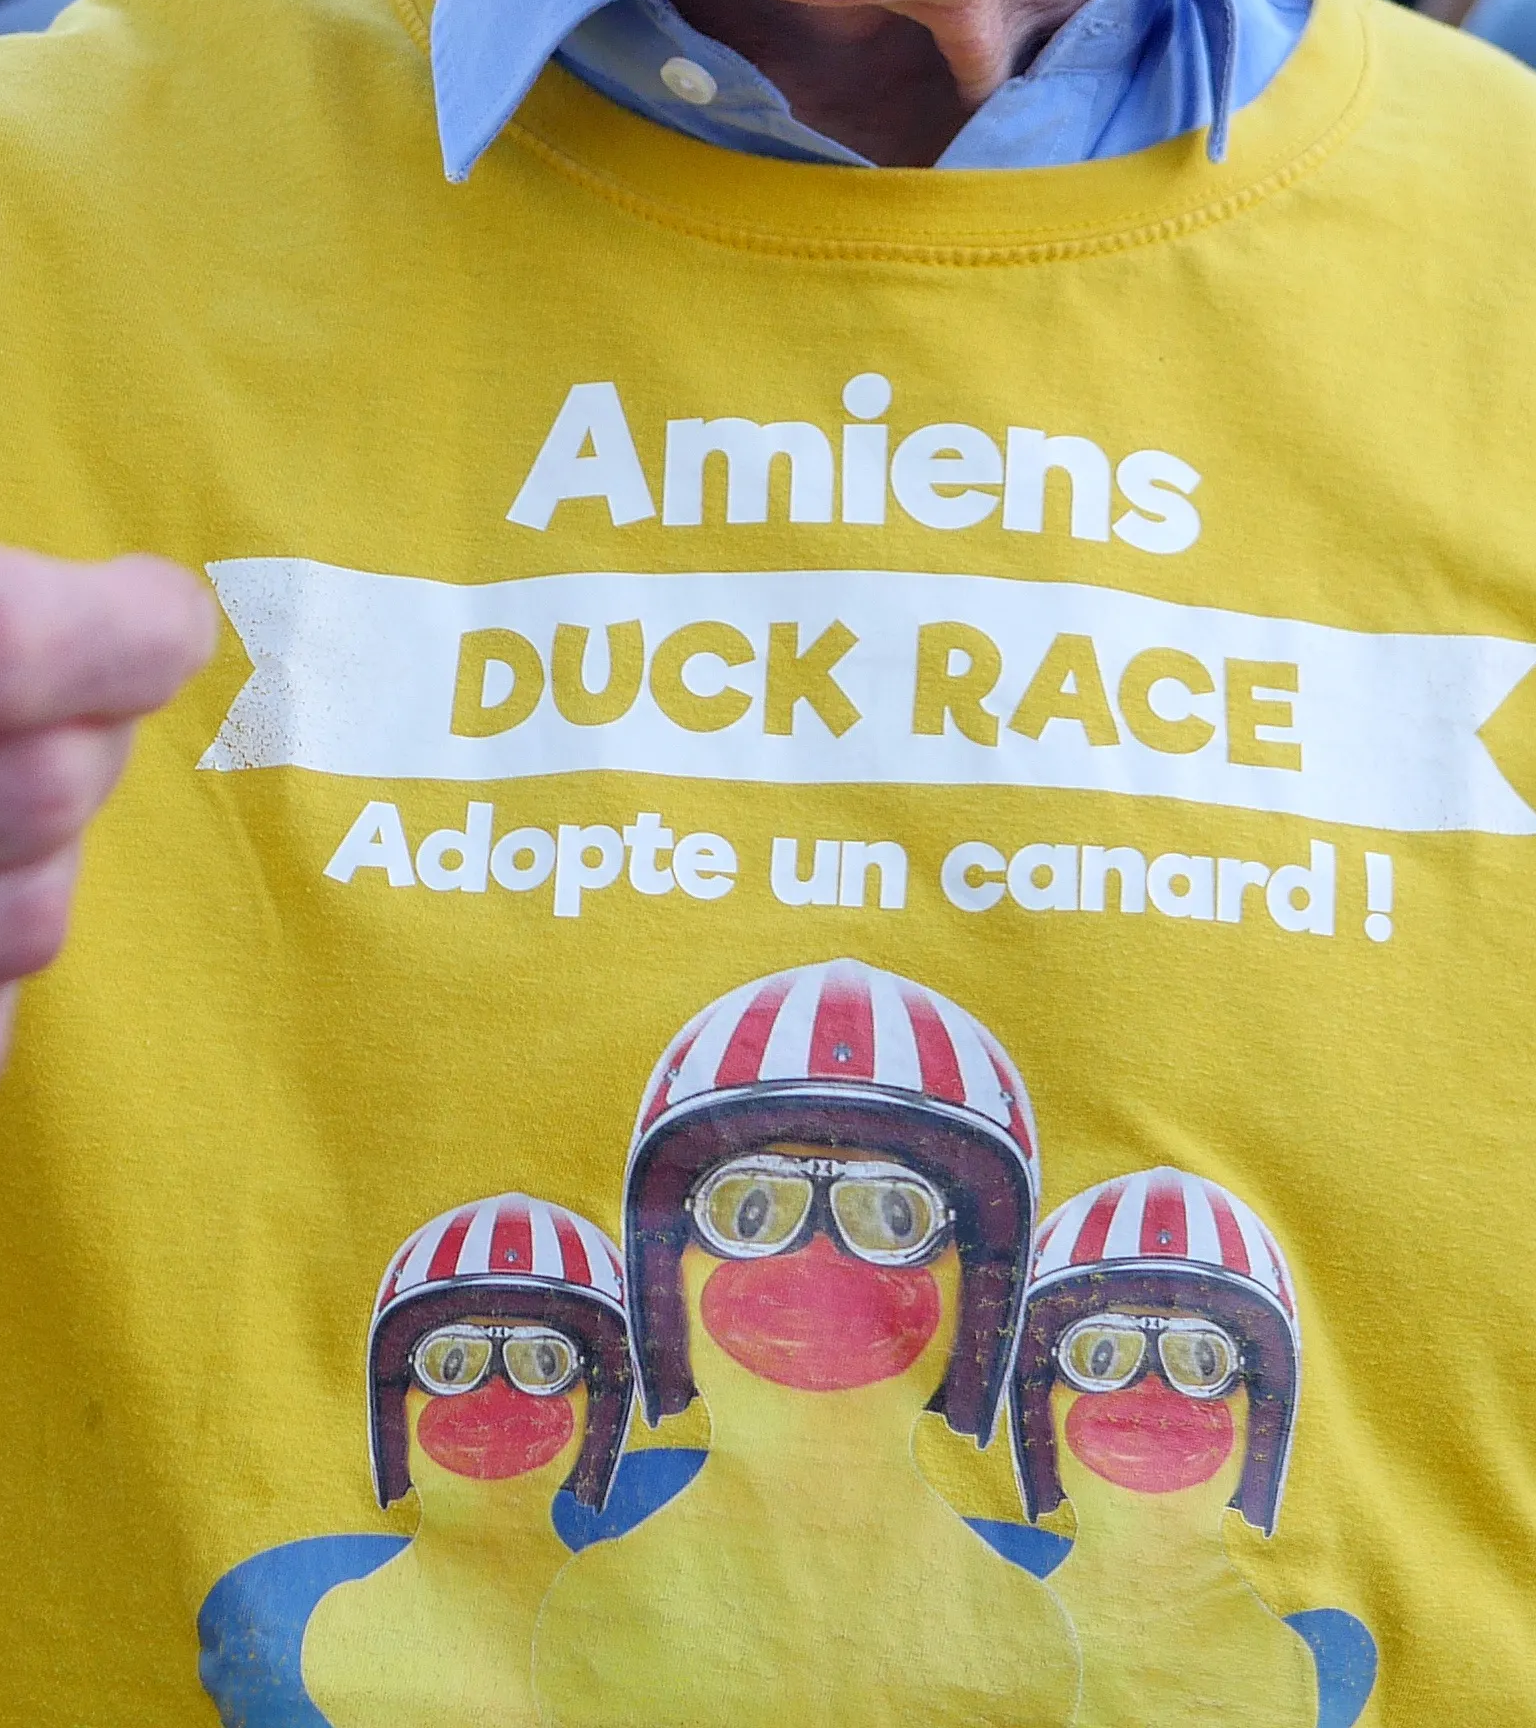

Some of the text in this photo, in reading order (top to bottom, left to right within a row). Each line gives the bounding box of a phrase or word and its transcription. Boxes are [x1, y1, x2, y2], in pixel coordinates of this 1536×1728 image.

[505, 372, 1203, 556] Amiens
[450, 619, 1302, 772] DUCK RACE
[323, 799, 1396, 943] Adopte un canard !
